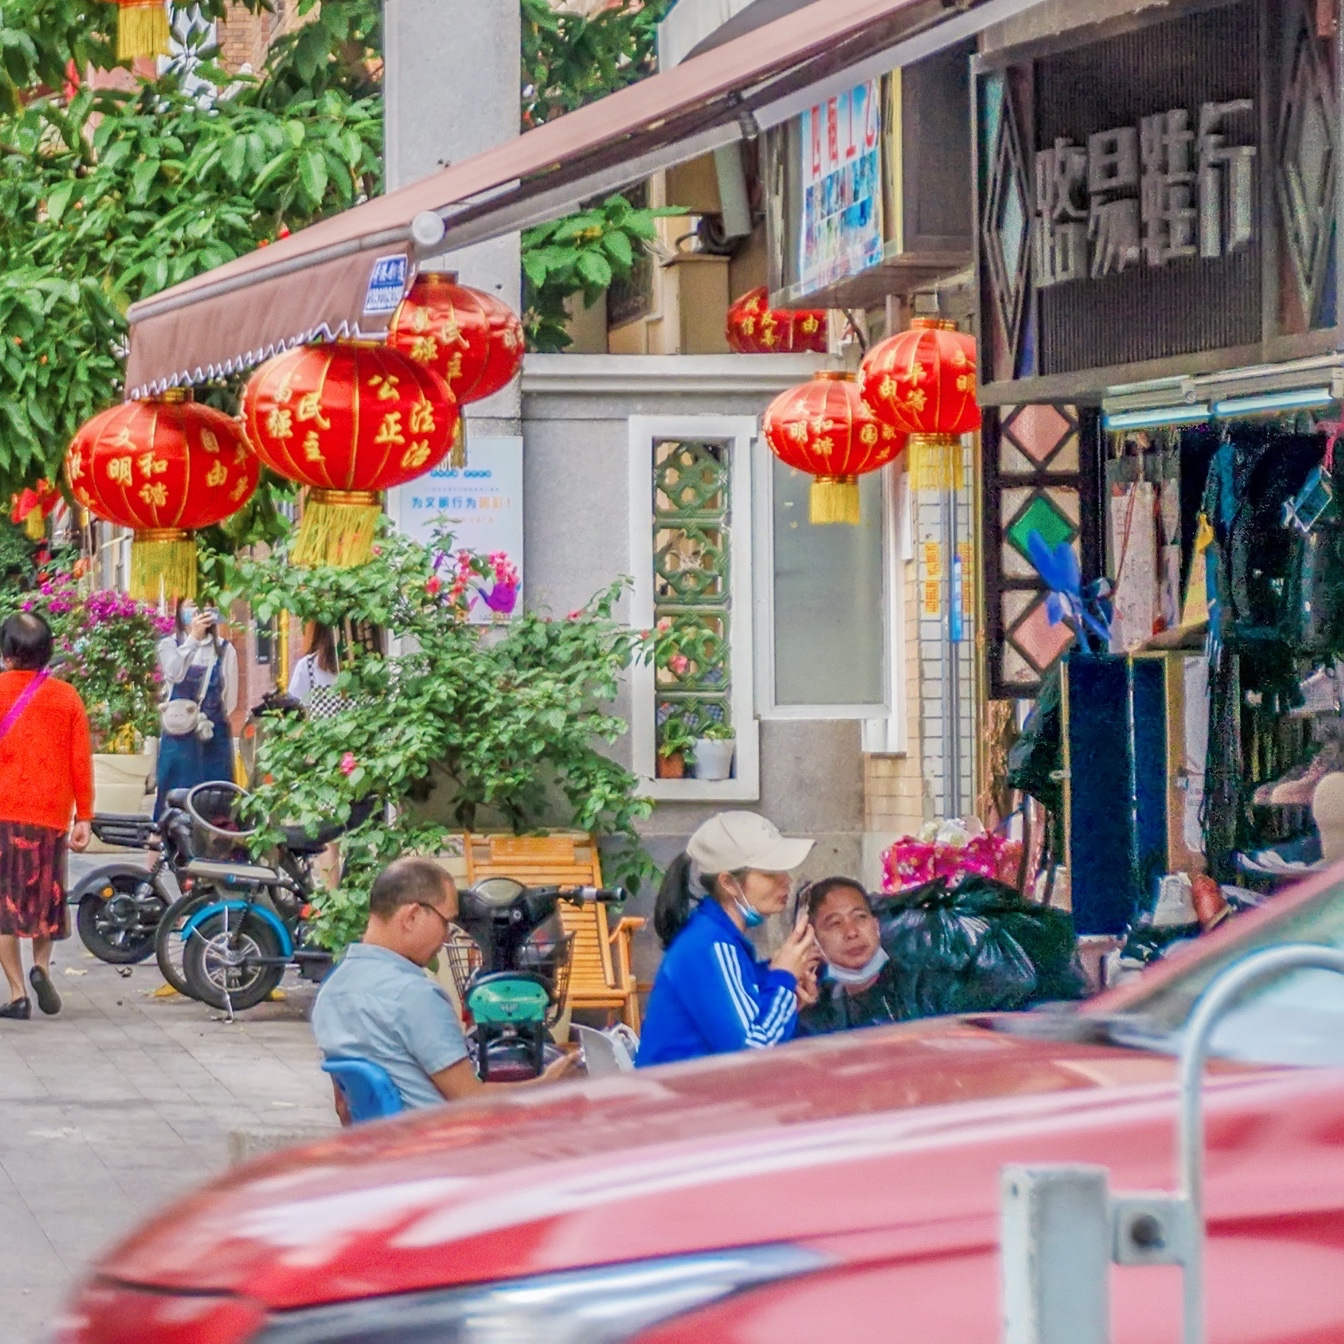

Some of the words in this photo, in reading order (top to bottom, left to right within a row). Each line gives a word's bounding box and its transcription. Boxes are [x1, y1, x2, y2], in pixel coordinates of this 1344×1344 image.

[441, 321, 471, 378] 民主
[369, 375, 405, 444] 公正
[903, 361, 928, 411] 平等
[297, 391, 331, 462] 民主
[400, 399, 437, 468] 法治
[789, 399, 810, 443] 文明
[811, 414, 835, 456] 和谐
[107, 426, 137, 487] 文明
[136, 450, 170, 507] 和谐
[200, 427, 229, 488] 自由
